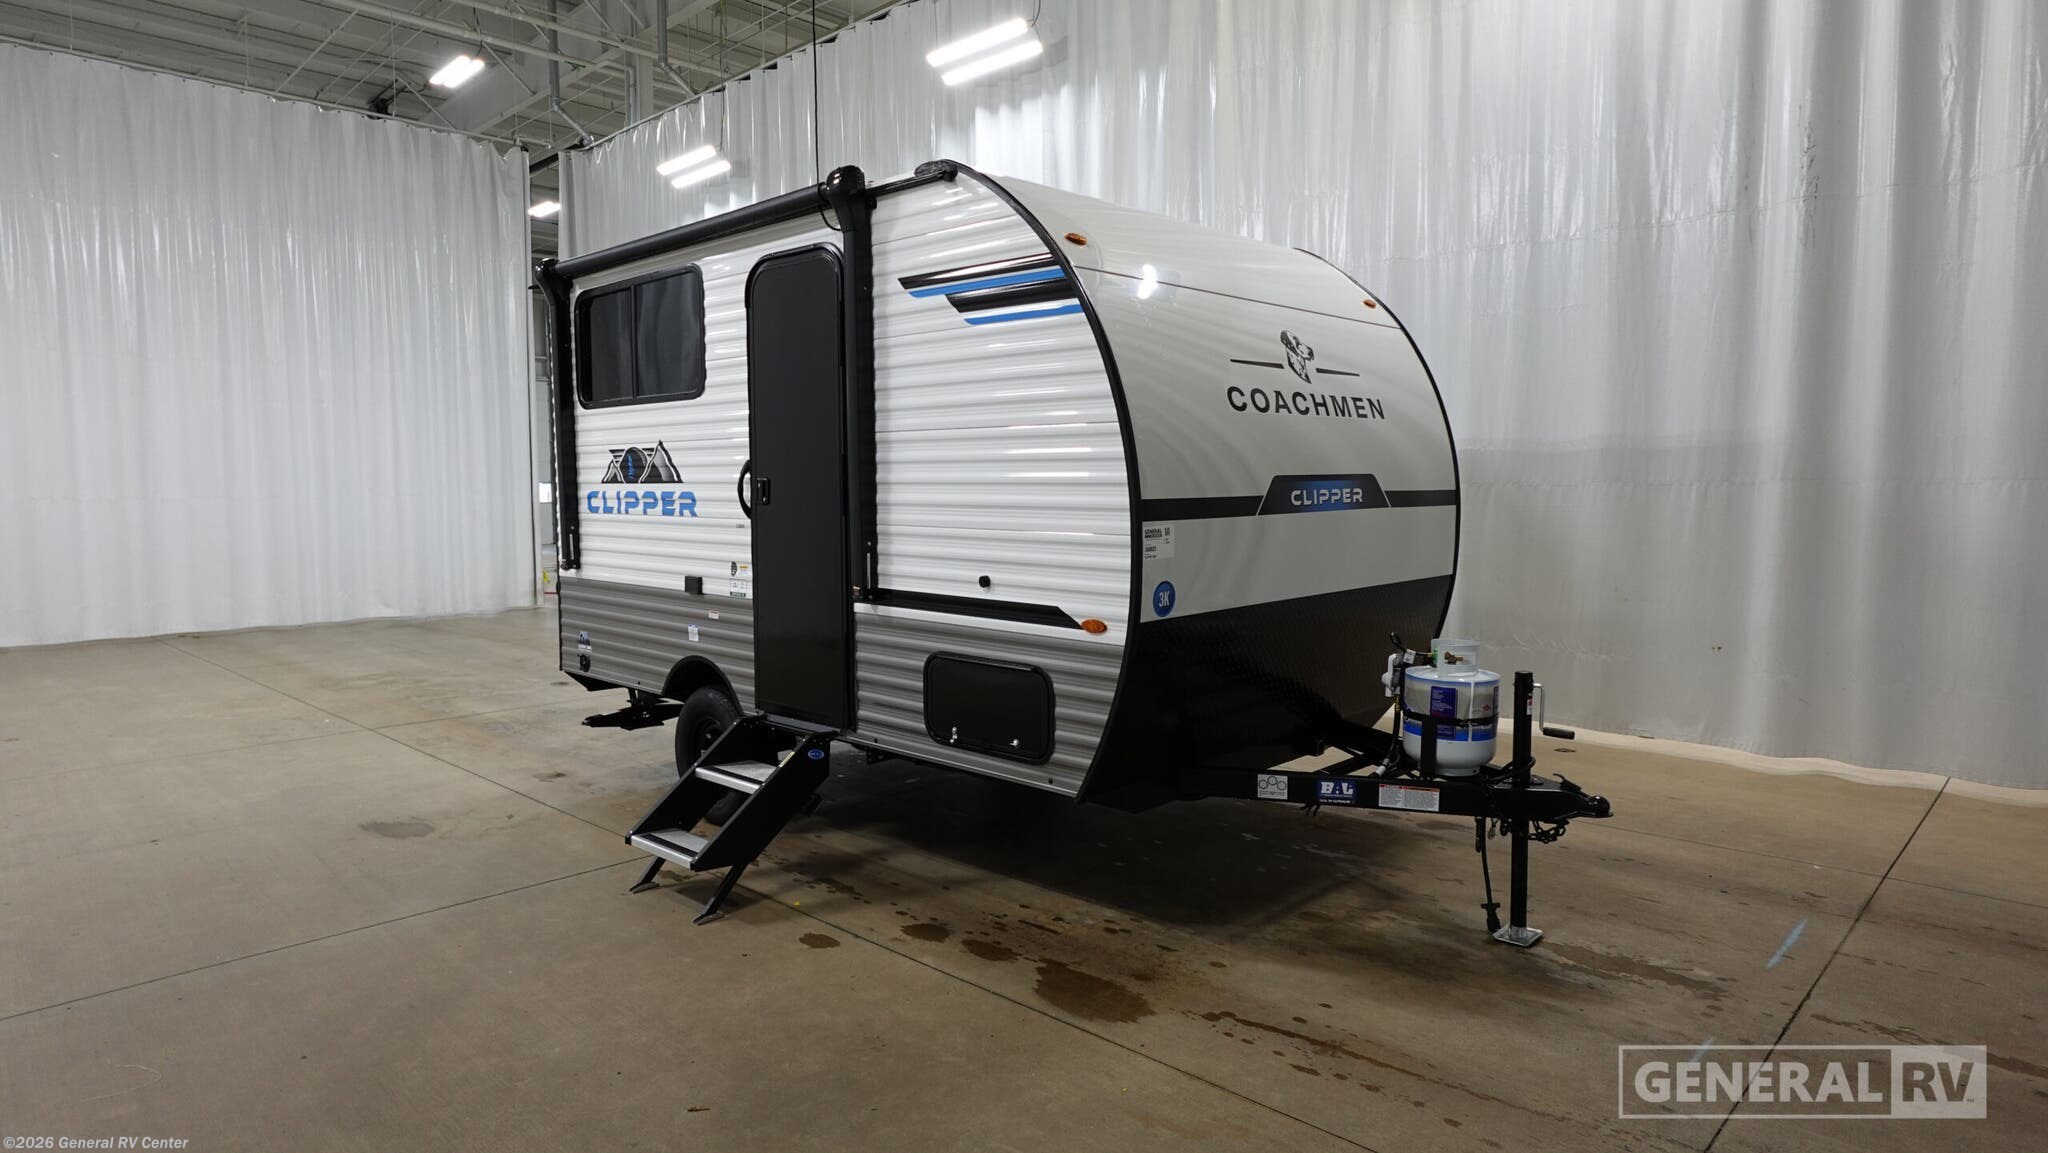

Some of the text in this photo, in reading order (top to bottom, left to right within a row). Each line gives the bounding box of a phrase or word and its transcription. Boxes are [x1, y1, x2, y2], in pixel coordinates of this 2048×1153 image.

[1226, 385, 1385, 420] COACHMEN
[586, 490, 698, 517] CLIPPER
[1290, 487, 1363, 506] CLIPPER
[1158, 590, 1170, 607] 3K
